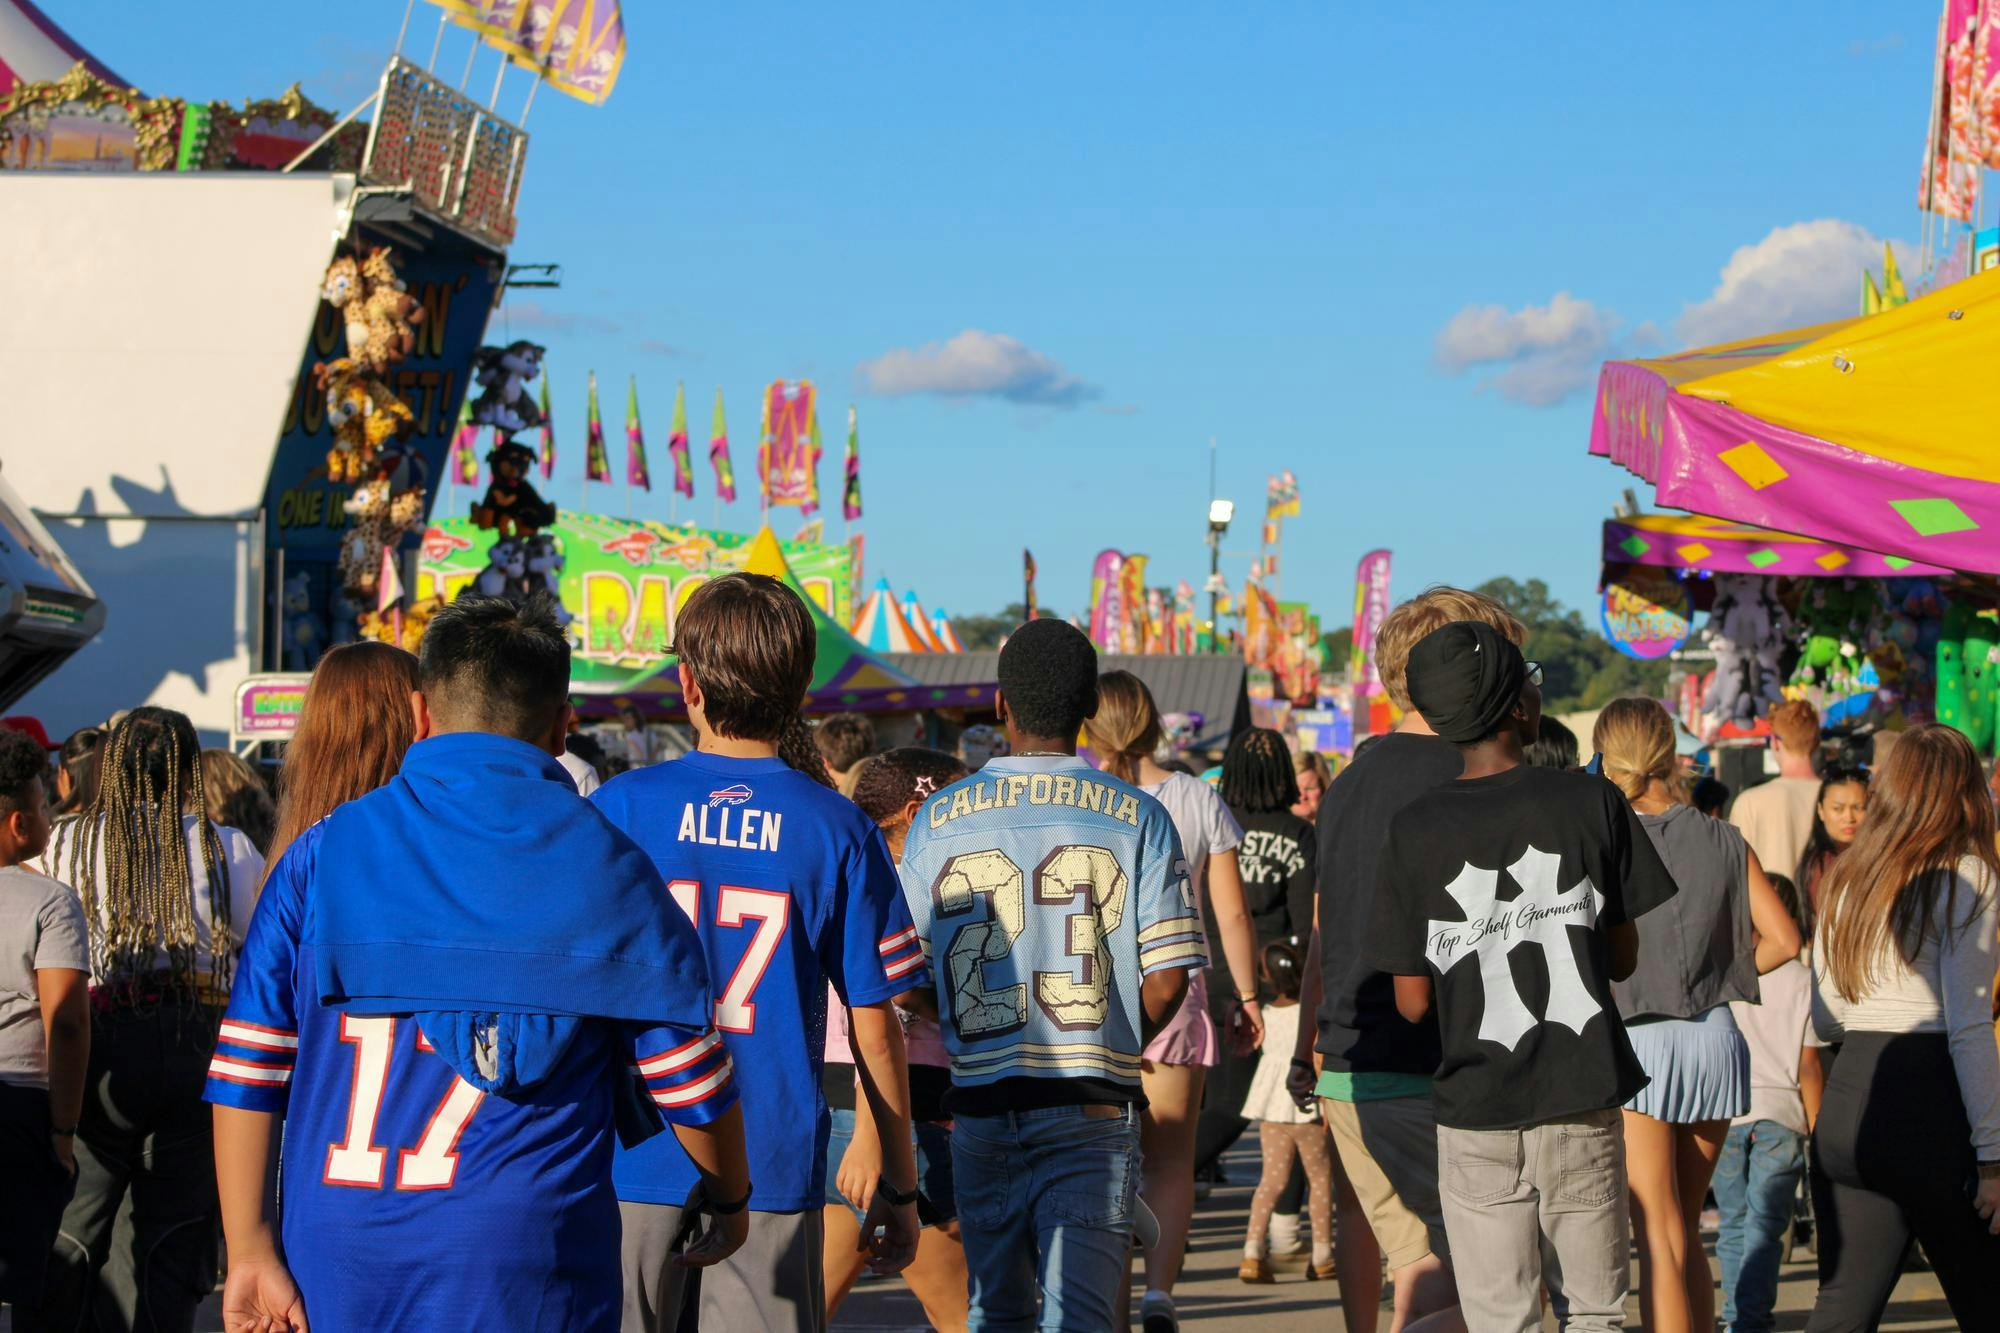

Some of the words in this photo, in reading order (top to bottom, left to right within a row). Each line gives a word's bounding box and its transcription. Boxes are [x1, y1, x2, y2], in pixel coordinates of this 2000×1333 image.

[278, 489, 323, 529] ONE
[1605, 611, 1689, 642] WATERS
[677, 803, 782, 852] ALLEN
[929, 774, 1141, 829] CALIFORNIA
[932, 845, 1128, 1042] 23
[1428, 927, 1460, 957] Top
[1466, 912, 1513, 946] Shelf
[1516, 892, 1592, 929] Garments
[323, 1012, 487, 1191] 17
